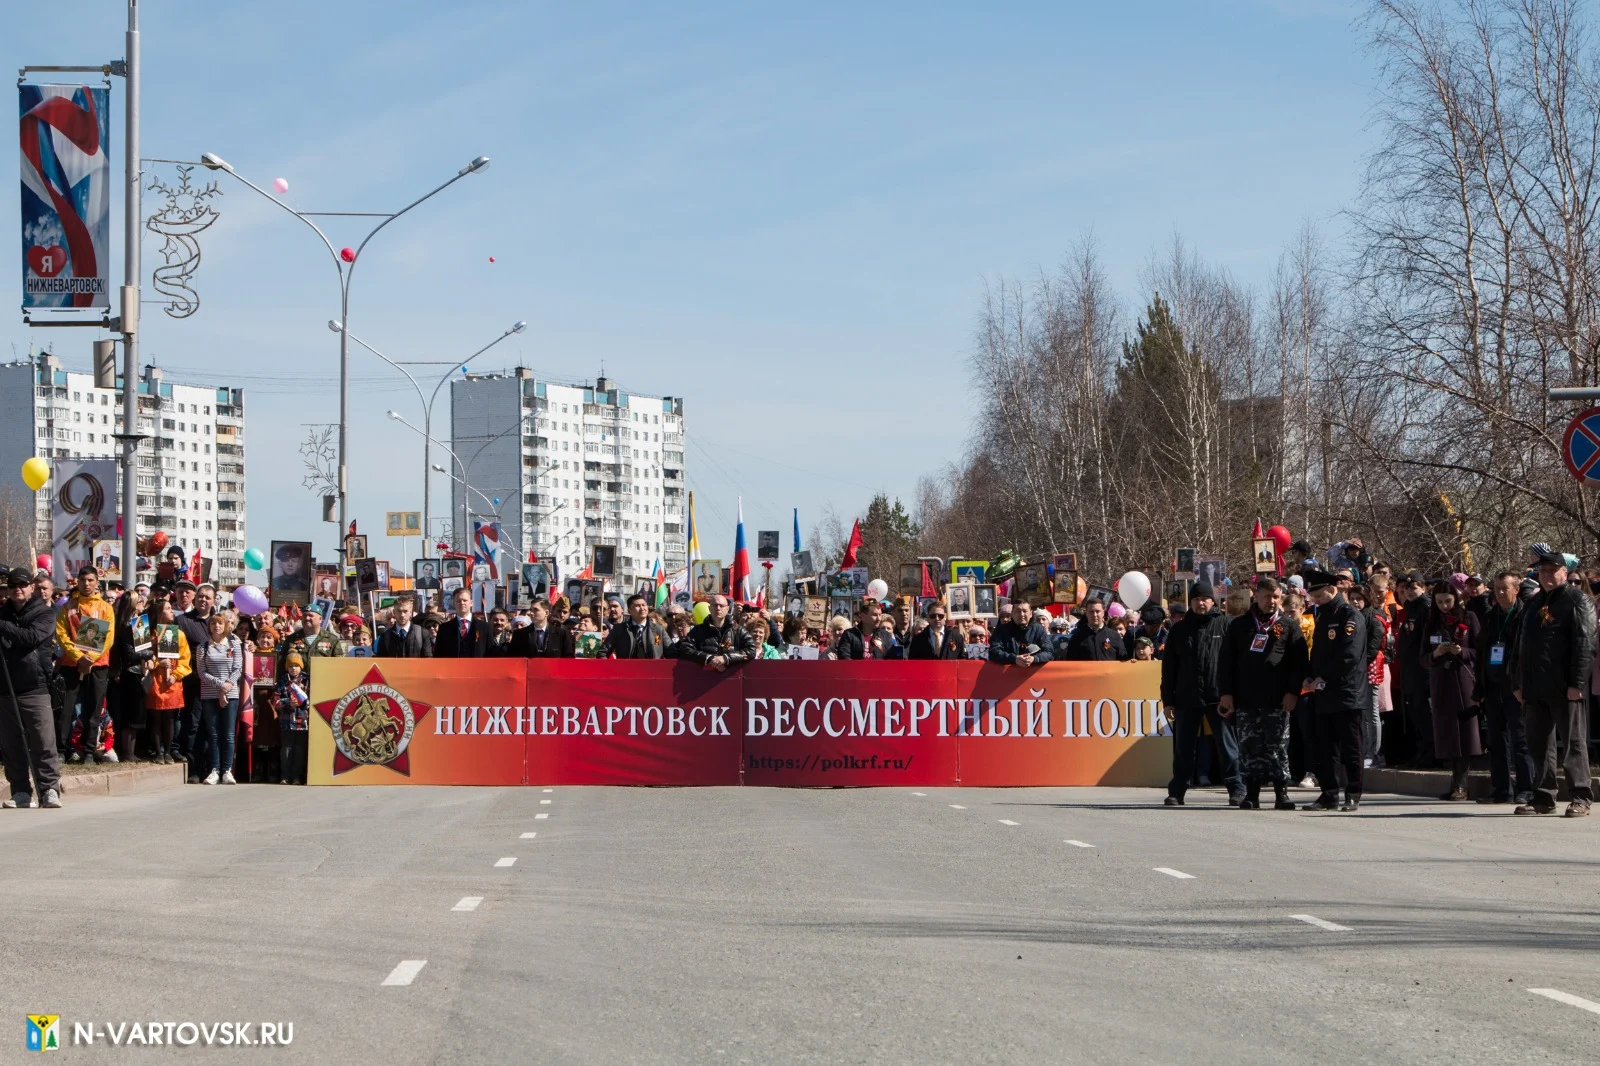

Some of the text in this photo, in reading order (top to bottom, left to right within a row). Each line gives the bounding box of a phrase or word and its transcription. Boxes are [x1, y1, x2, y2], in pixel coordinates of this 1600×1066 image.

[41, 255, 53, 273] Я
[27, 278, 103, 293] НИЖНЕВАРТОВСК
[376, 685, 401, 701] ПОЛК
[400, 699, 413, 740] РОССИИ
[433, 706, 732, 737] НИЖНЕВАРТОВСК
[745, 687, 1053, 738] БЕССМЕРТНЫЙ
[750, 755, 913, 772] https://polkrf.ru/
